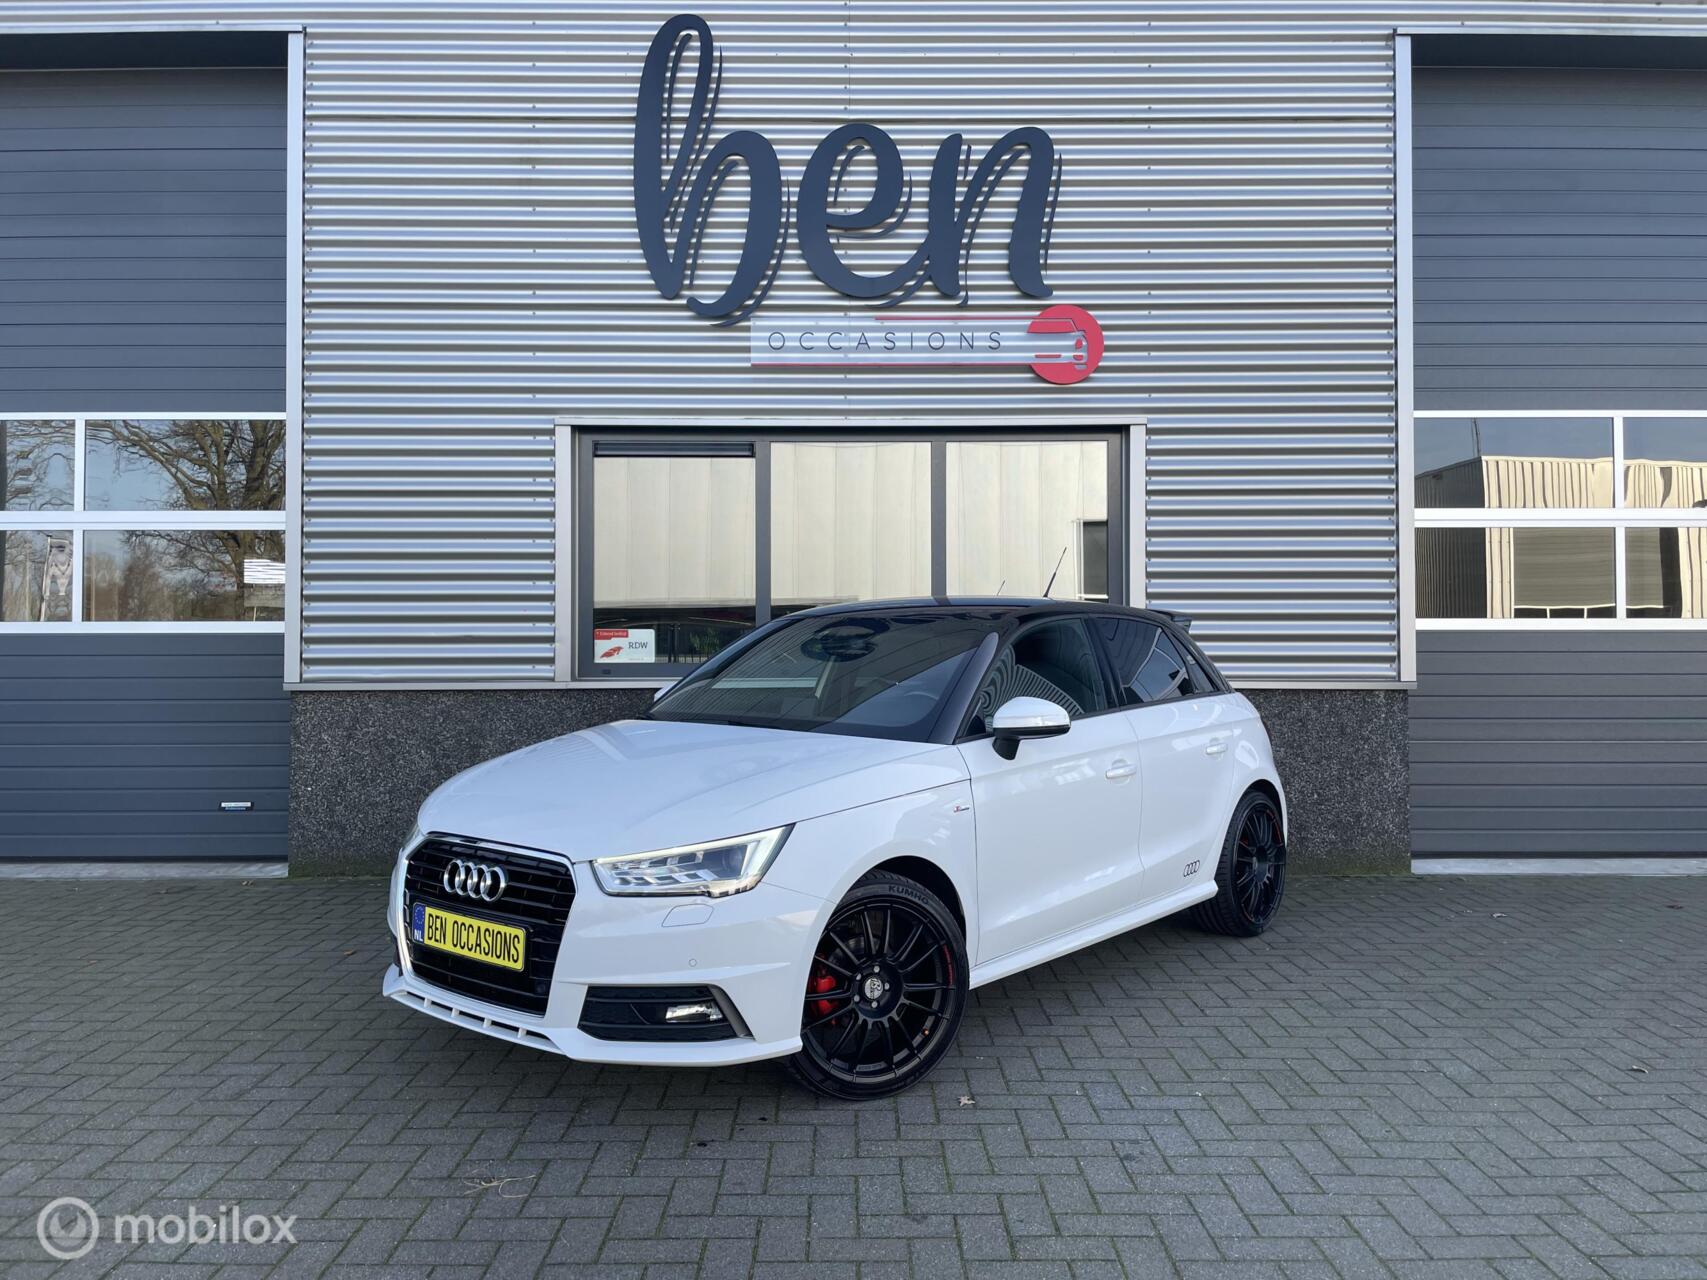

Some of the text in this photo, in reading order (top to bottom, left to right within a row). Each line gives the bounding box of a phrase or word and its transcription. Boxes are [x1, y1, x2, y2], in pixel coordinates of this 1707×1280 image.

[633, 13, 1060, 324] ben
[767, 331, 1002, 351] OCCASIONS
[628, 641, 648, 649] RDW
[888, 884, 929, 905] KUMHO
[414, 929, 424, 942] NL
[427, 913, 520, 964] BEN OCCASIONS
